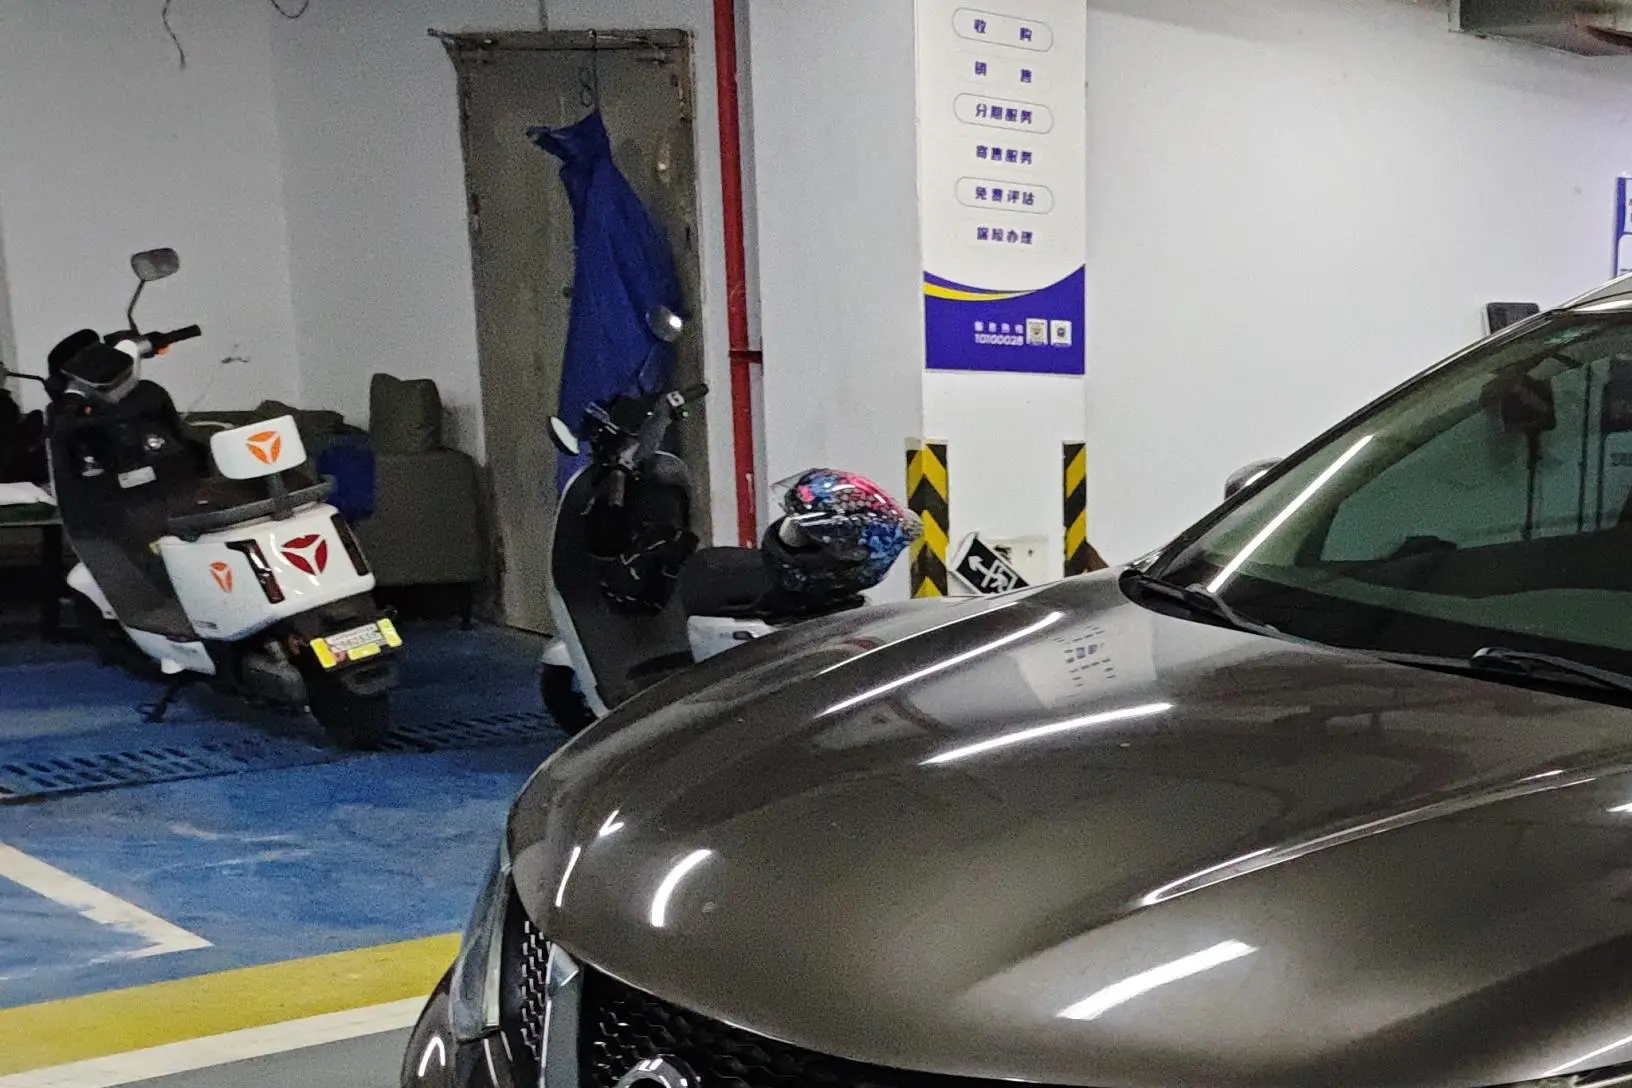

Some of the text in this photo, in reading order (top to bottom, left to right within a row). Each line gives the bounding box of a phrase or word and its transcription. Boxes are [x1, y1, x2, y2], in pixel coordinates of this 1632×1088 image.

[975, 103, 1033, 124] 分期服务
[975, 186, 1034, 206] 免费评估
